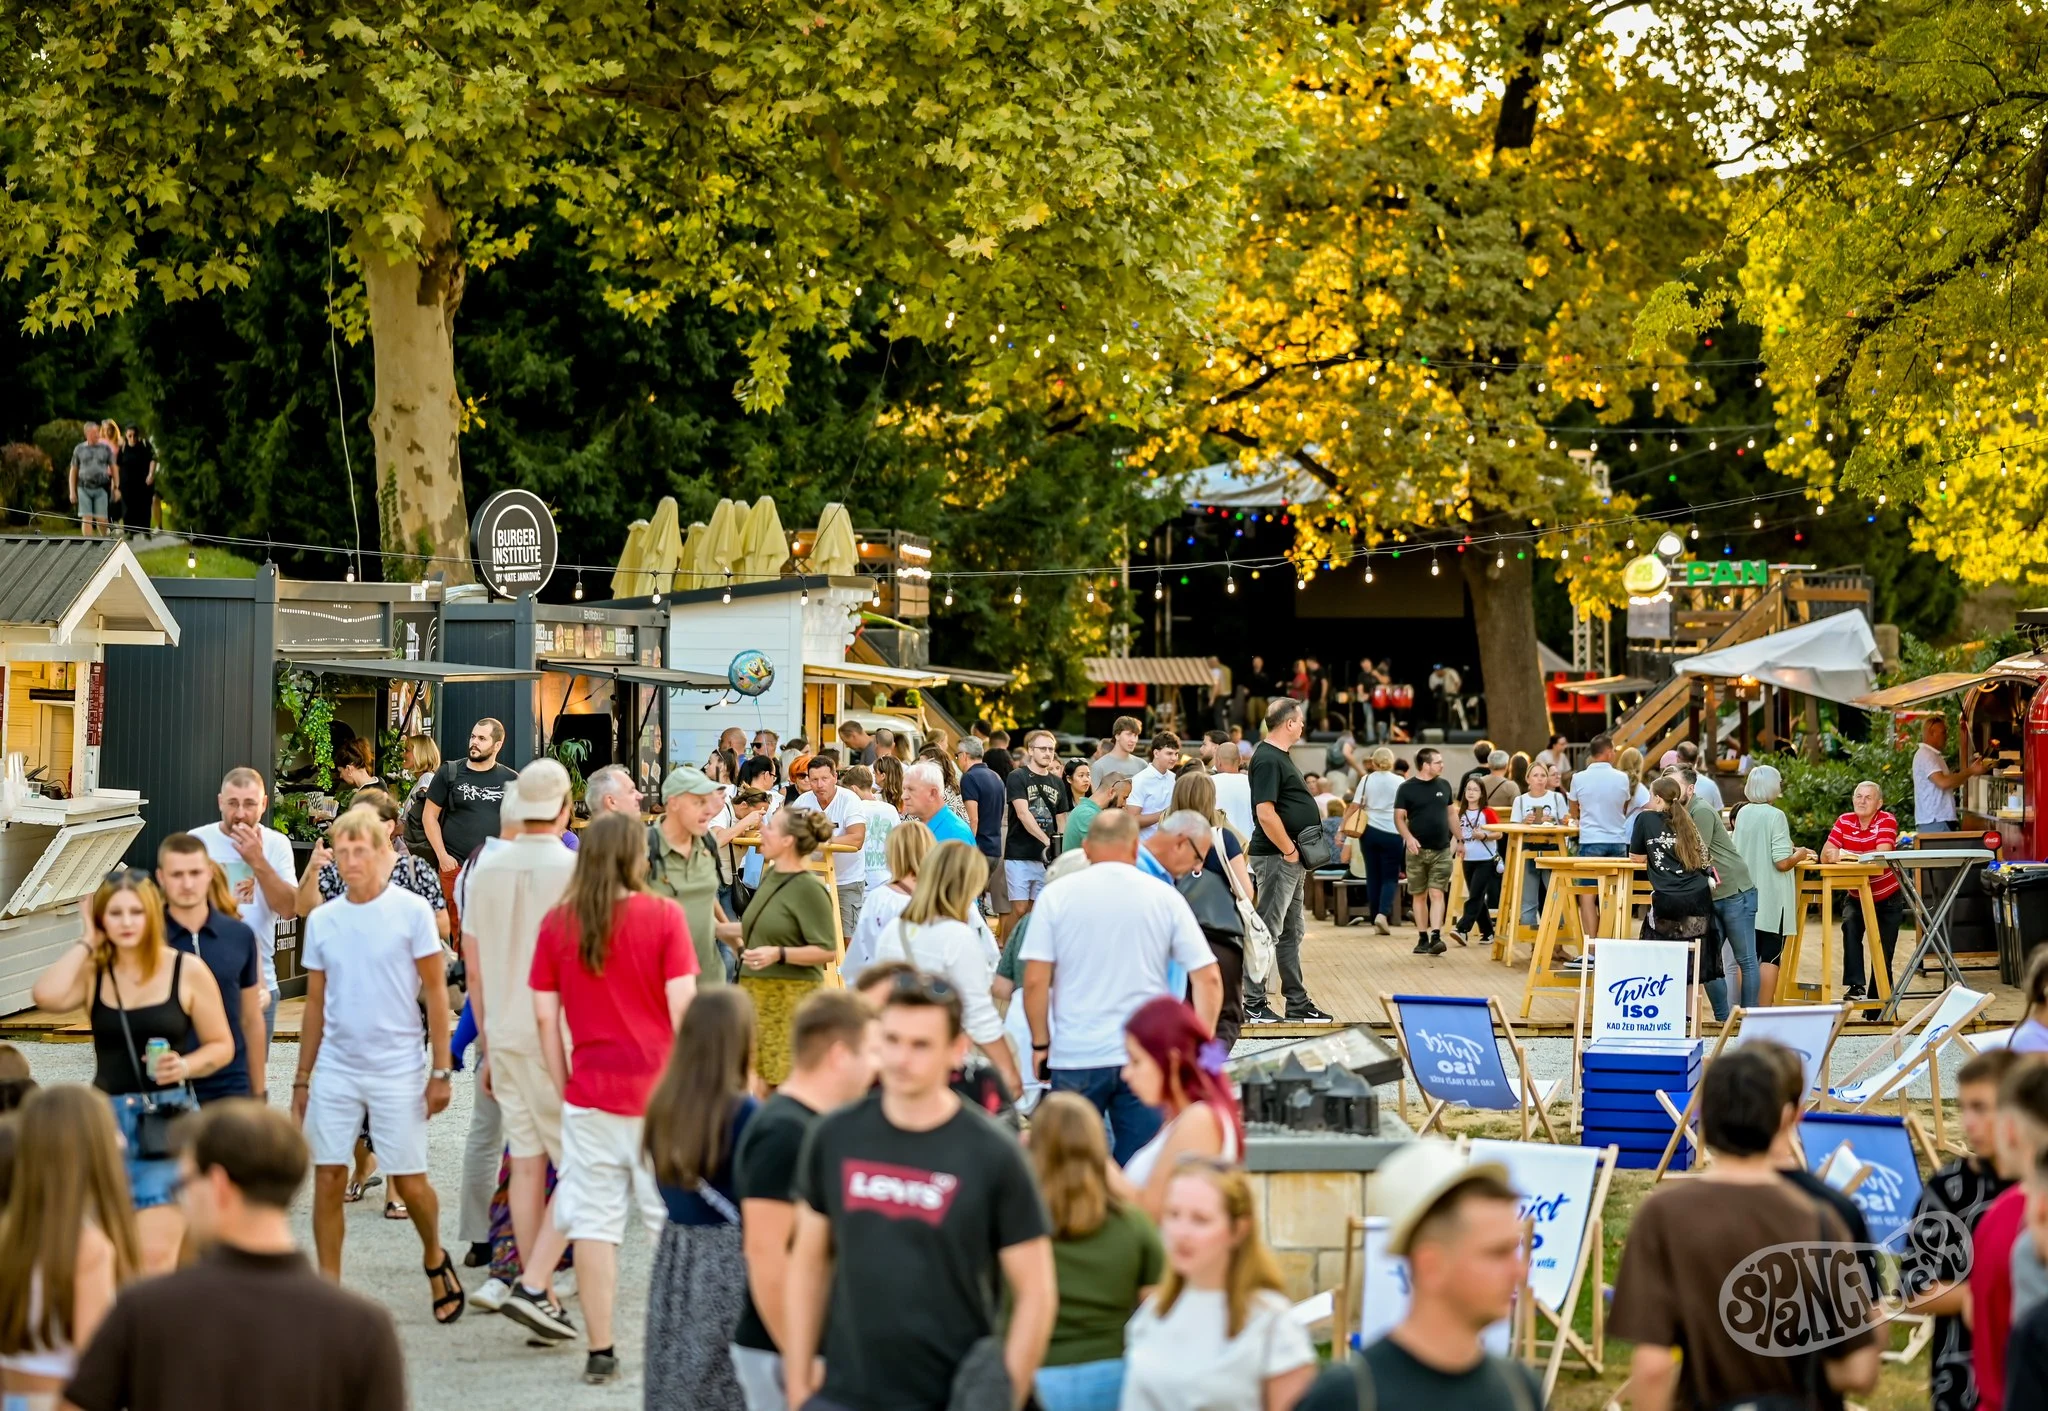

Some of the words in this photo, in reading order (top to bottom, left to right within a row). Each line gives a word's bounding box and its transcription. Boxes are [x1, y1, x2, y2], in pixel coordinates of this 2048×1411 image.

[497, 528, 536, 547] BURGER
[492, 546, 542, 564] INSTITUTE
[496, 573, 503, 583] BY
[1686, 560, 1768, 587] PAN
[1608, 974, 1674, 1006] Twist
[1622, 1004, 1659, 1019] ISO
[1606, 1022, 1621, 1030] KAD
[1622, 1022, 1635, 1031] ŽED
[1636, 1022, 1656, 1031] TRAŽI
[1656, 1022, 1672, 1031] VIŠE
